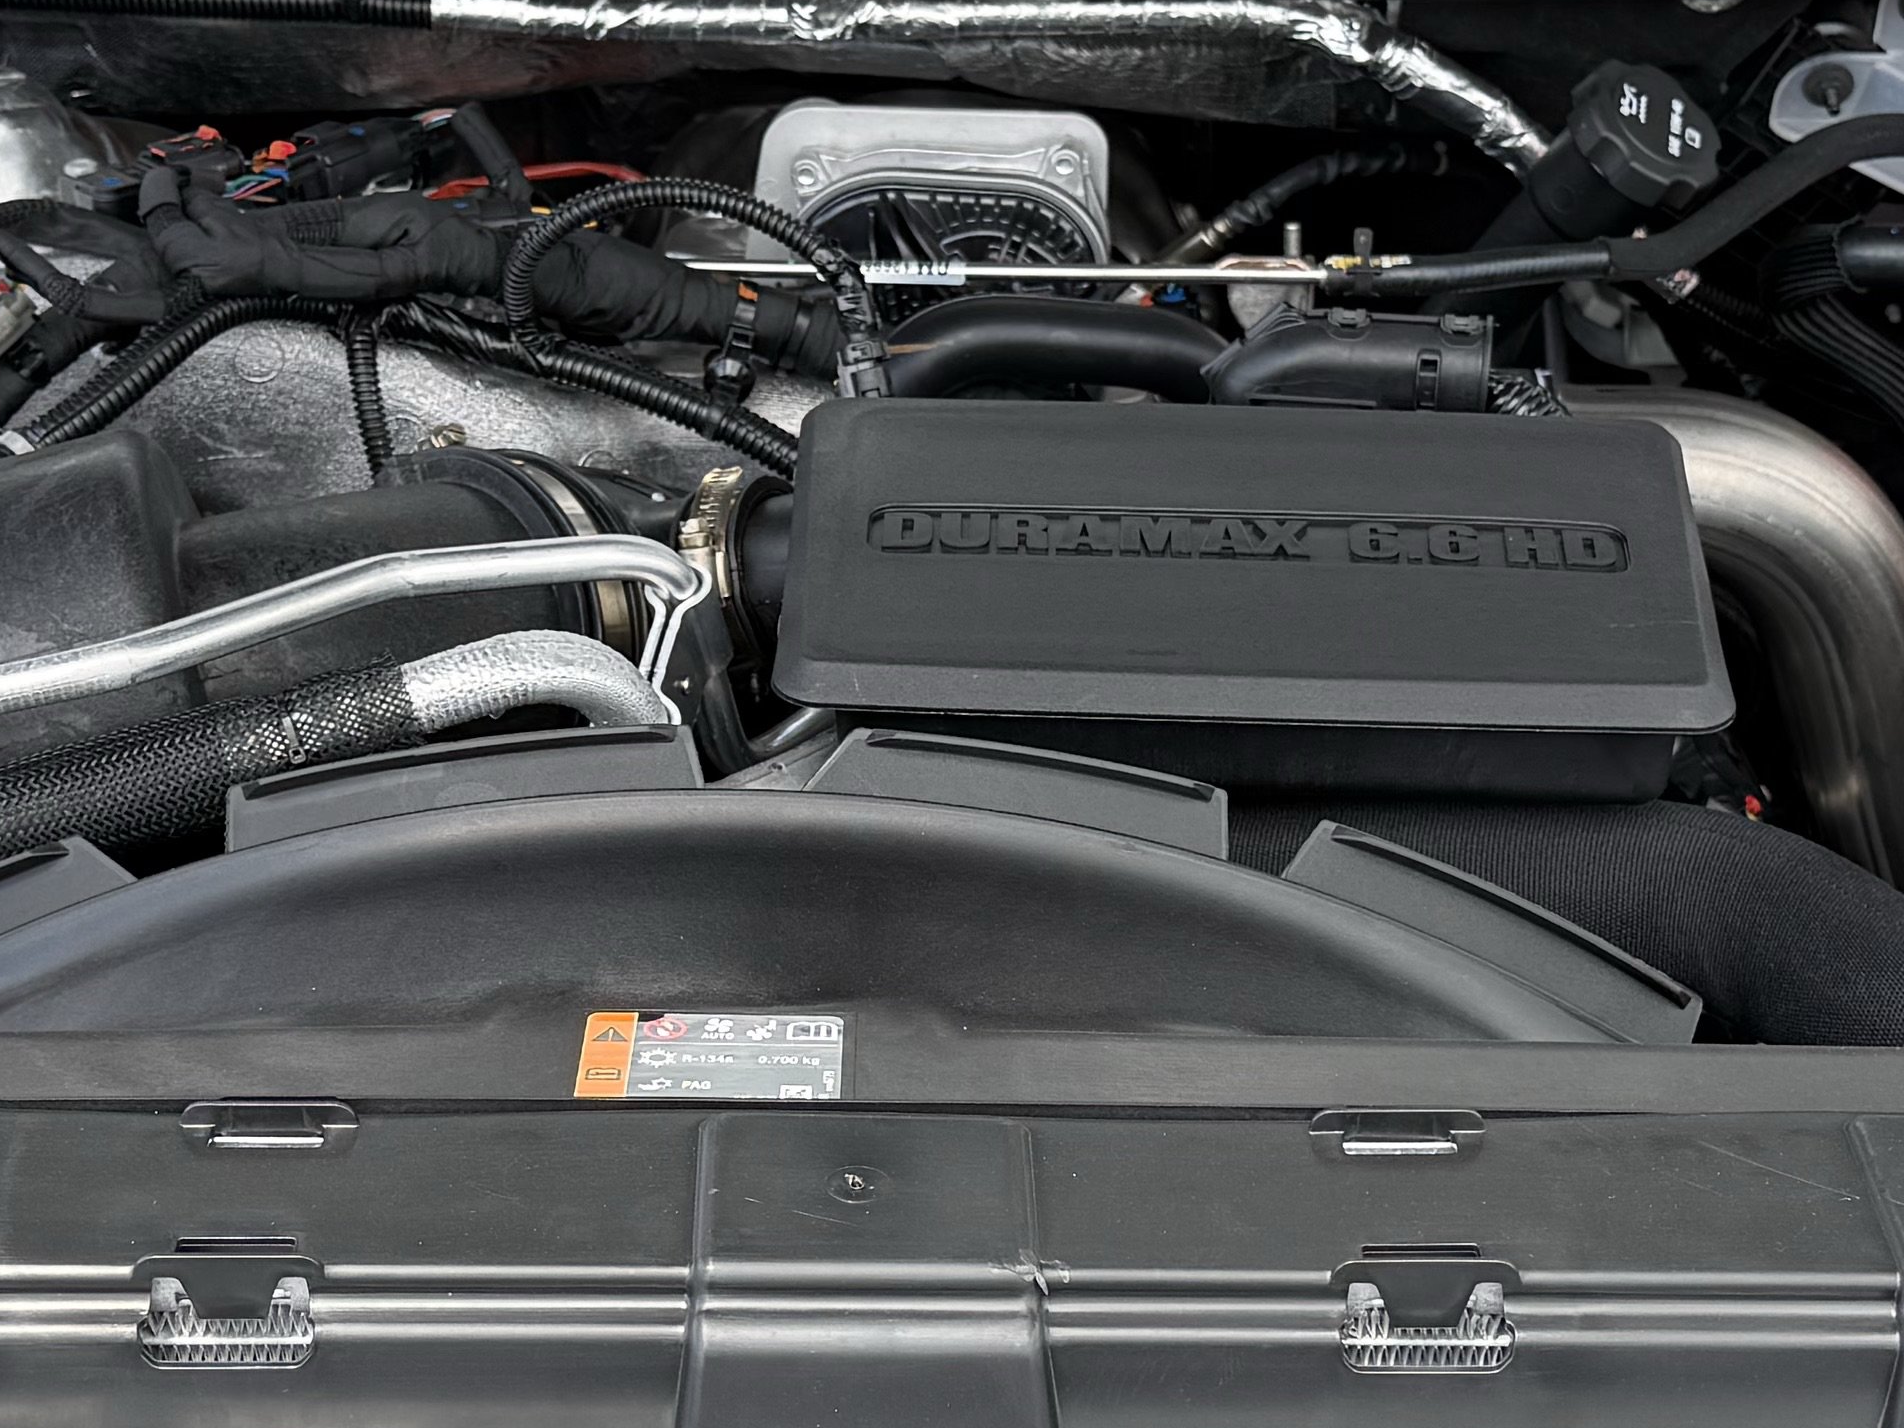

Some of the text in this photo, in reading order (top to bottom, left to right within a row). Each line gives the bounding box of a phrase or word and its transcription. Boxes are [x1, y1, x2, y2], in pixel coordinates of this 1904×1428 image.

[881, 512, 1619, 570] DURAMAX 6.6 HD
[701, 1032, 735, 1040] AUTO
[682, 1054, 821, 1066] R-134a 0.700 kg
[681, 1080, 712, 1089] PAG
